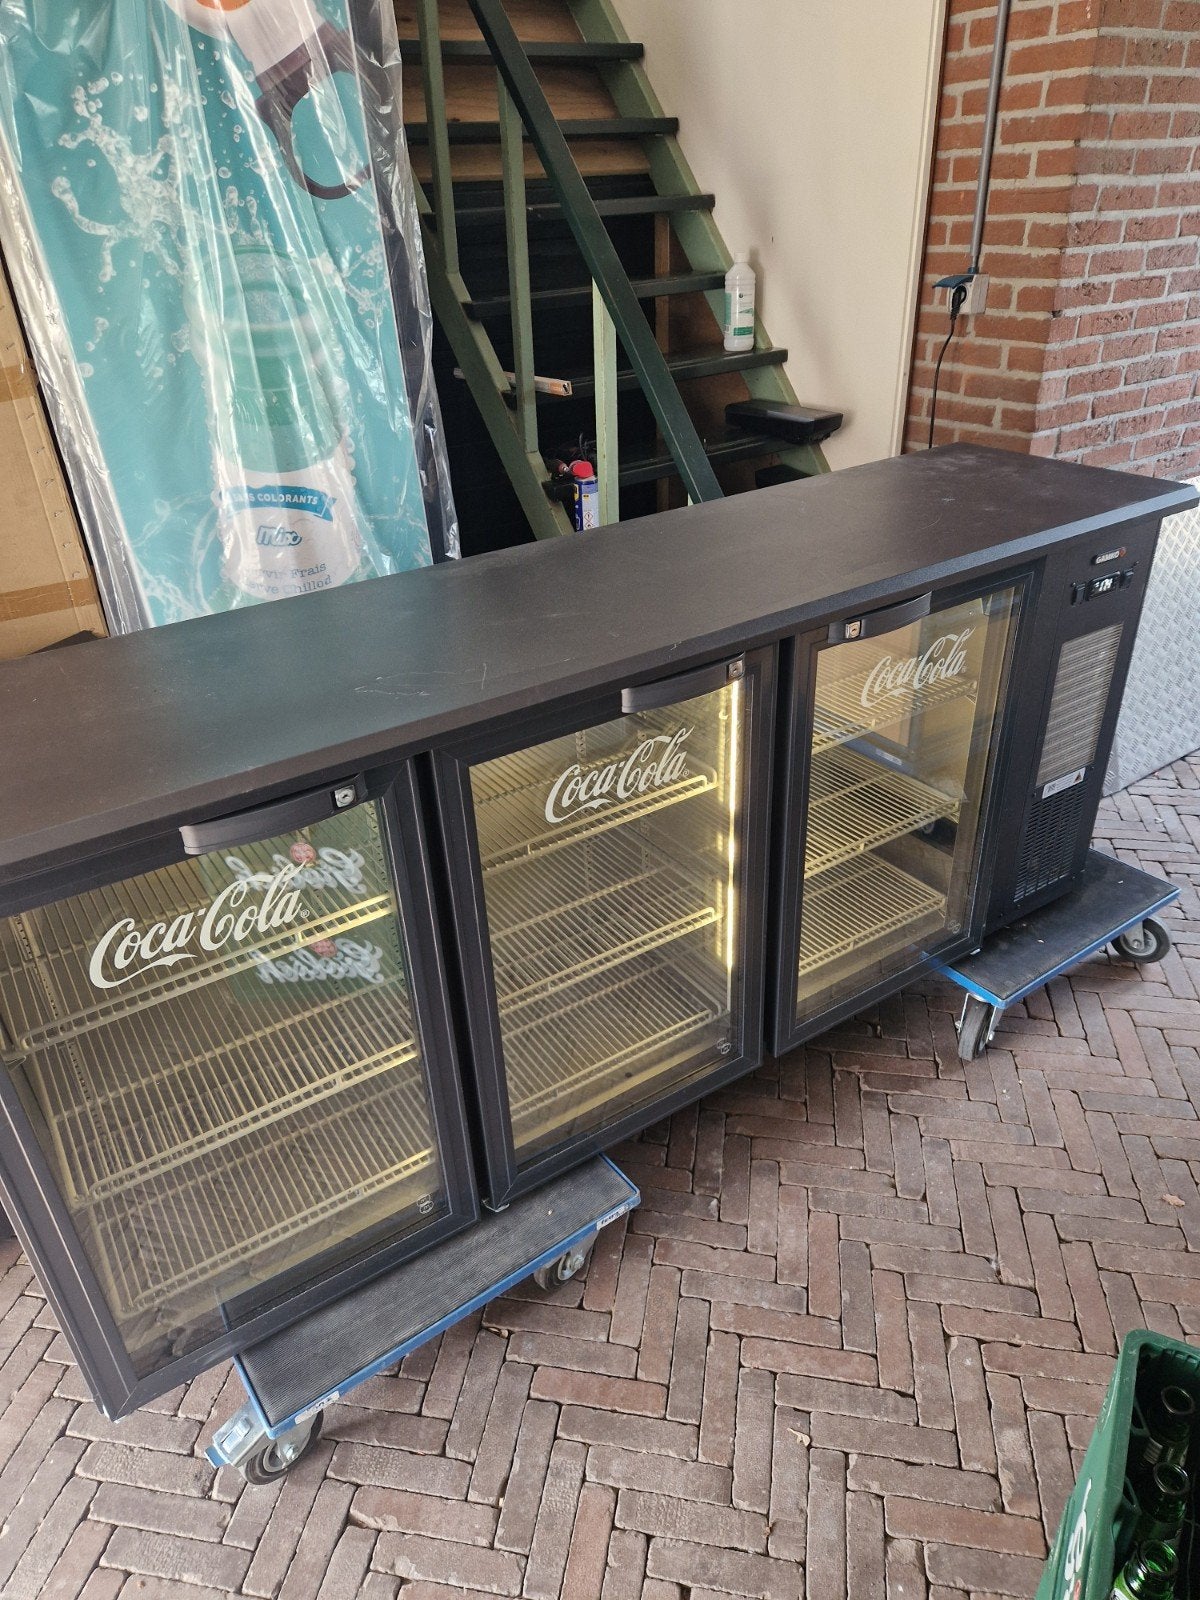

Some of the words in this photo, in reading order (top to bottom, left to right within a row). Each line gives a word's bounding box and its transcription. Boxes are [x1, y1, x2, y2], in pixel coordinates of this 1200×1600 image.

[233, 492, 255, 502] SAS
[256, 492, 318, 505] COLORANTS
[291, 563, 326, 579] Frais
[244, 580, 279, 595] erve
